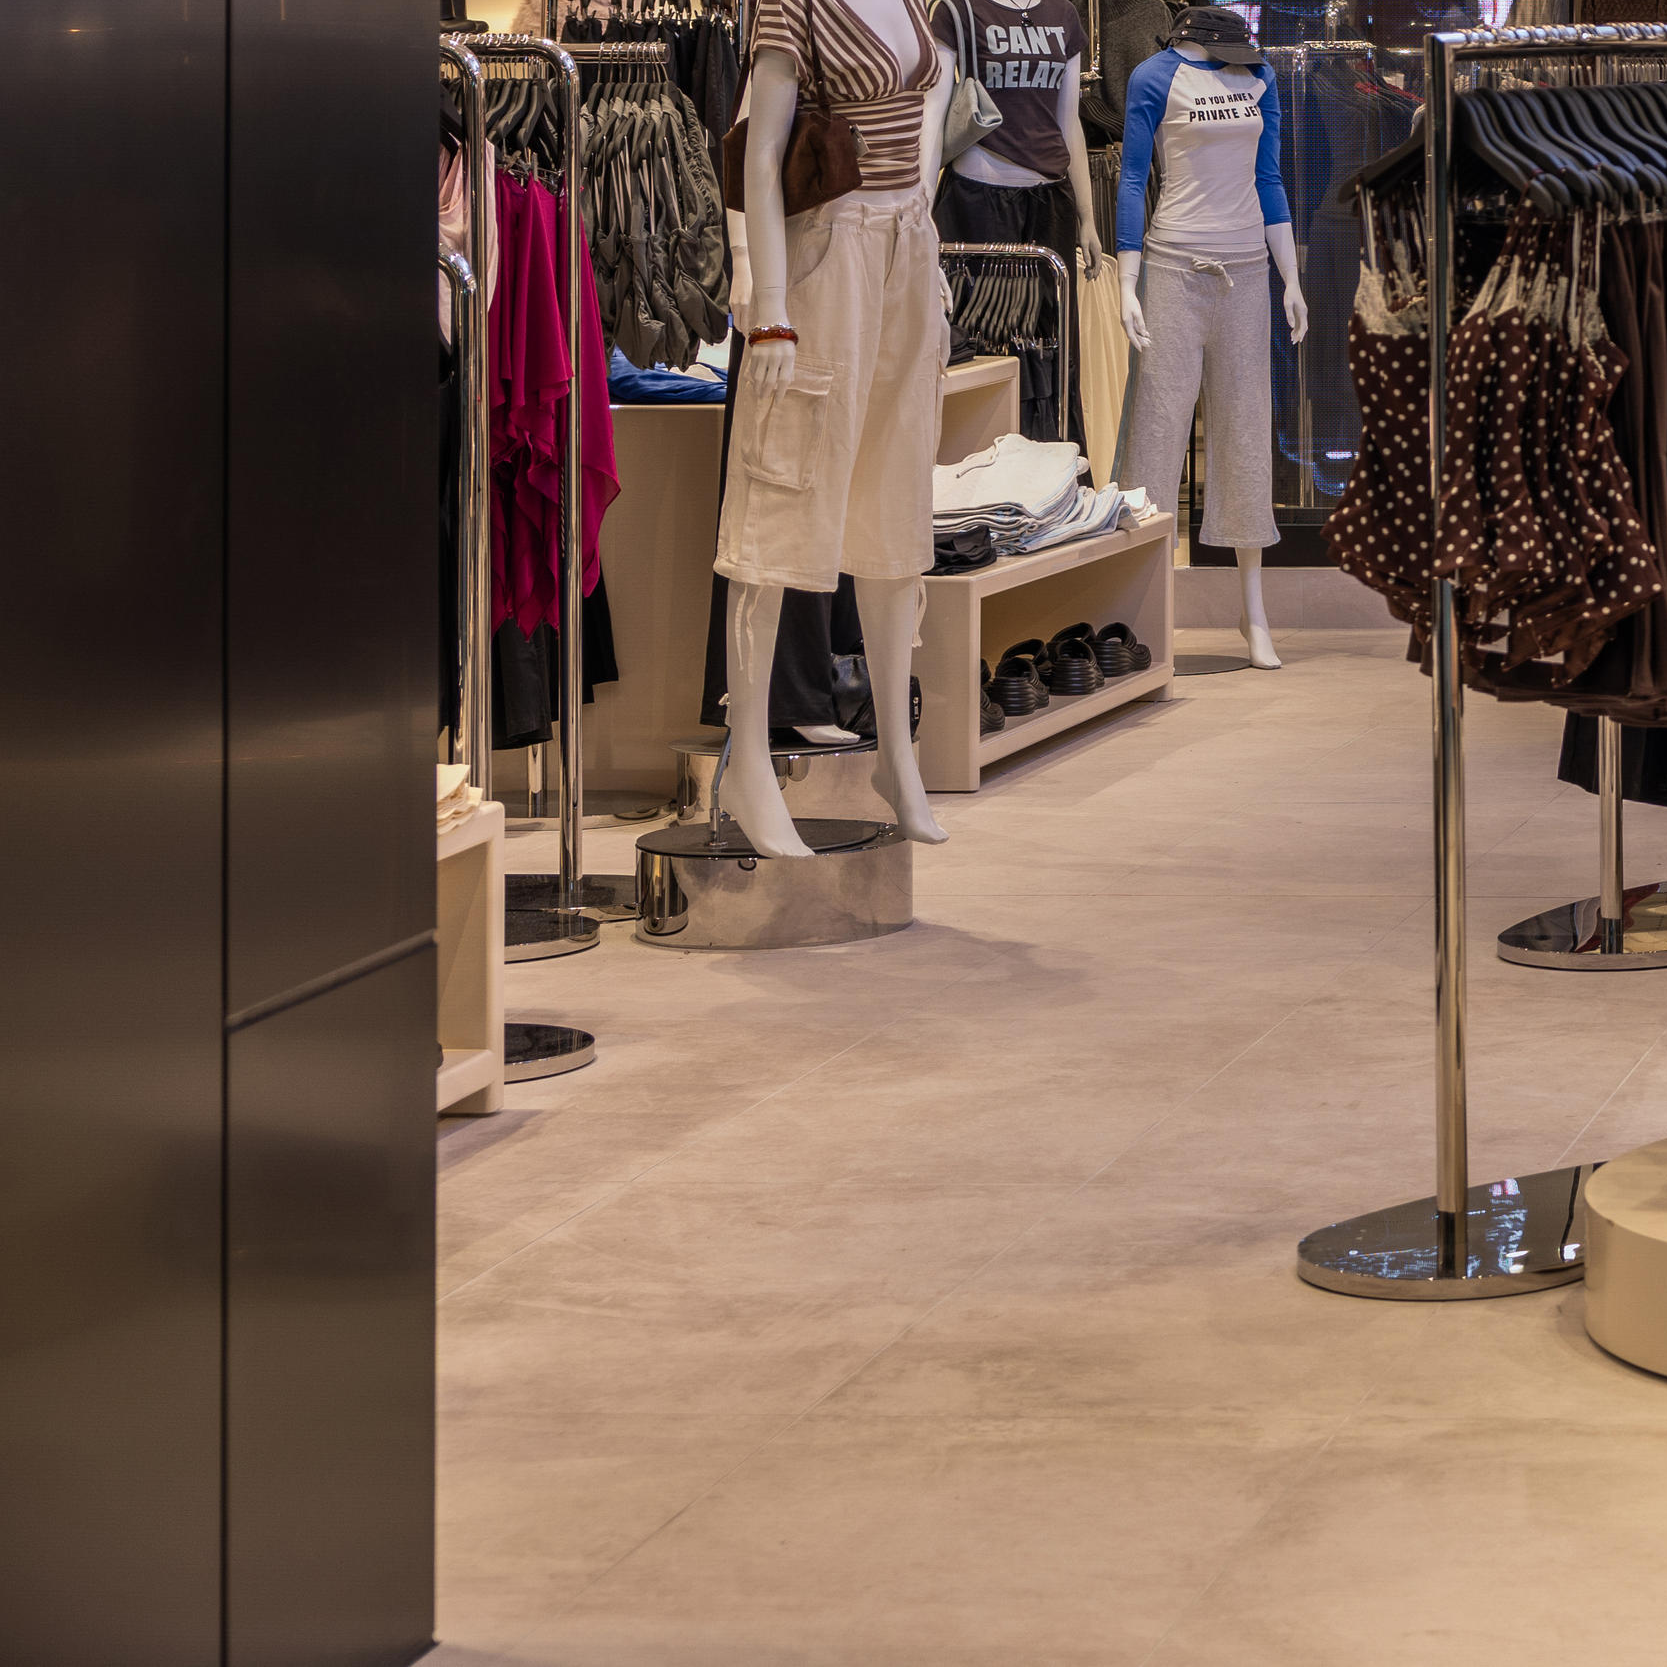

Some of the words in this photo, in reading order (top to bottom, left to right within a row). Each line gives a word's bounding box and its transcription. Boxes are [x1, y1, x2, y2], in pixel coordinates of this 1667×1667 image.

[985, 24, 1066, 55] CAN'T
[1194, 97, 1206, 106] DO
[1208, 95, 1225, 105] YOU
[1227, 93, 1248, 103] HAVE
[1189, 107, 1240, 122] PRIVATE
